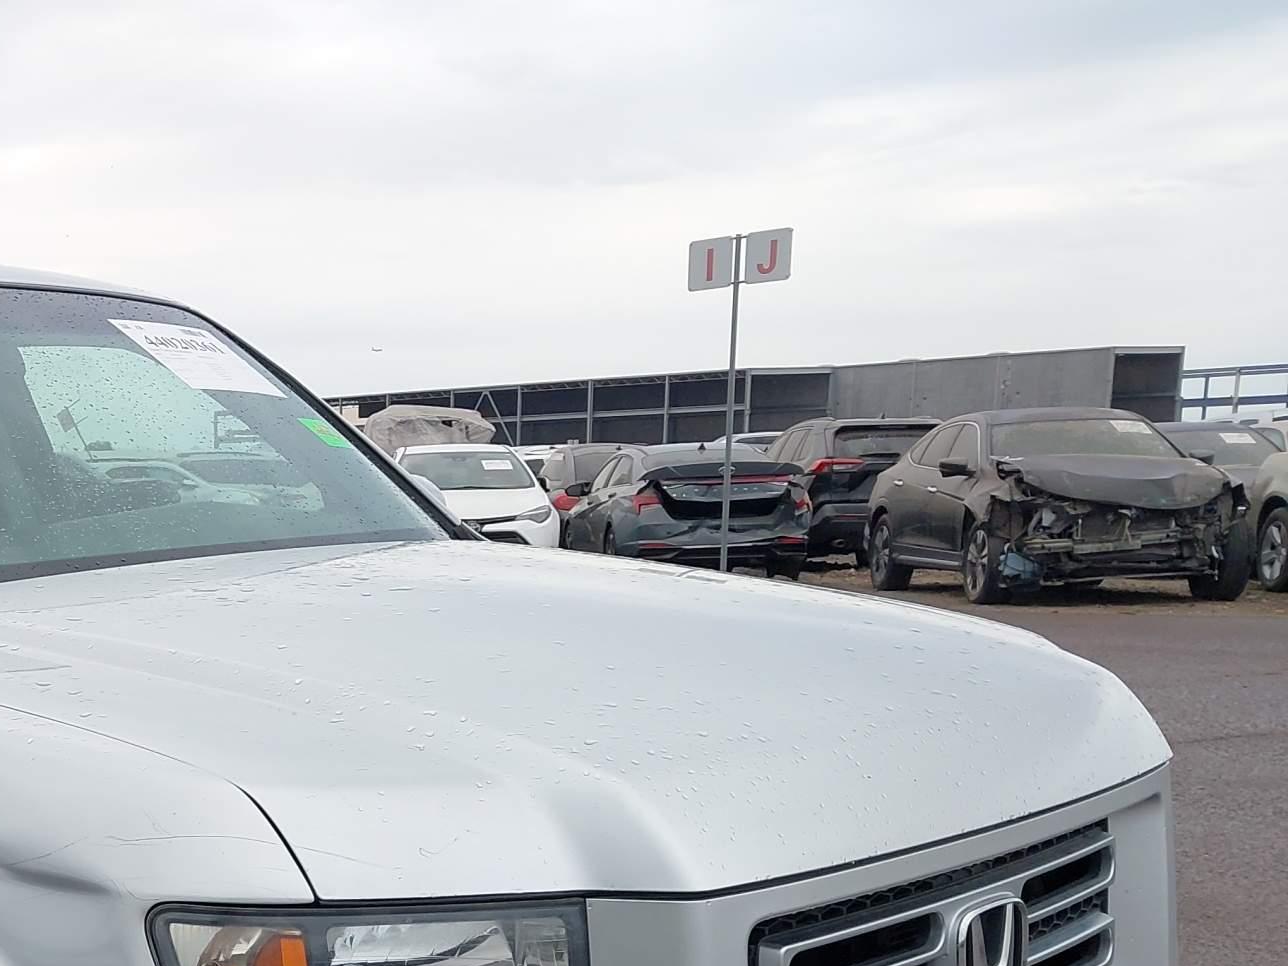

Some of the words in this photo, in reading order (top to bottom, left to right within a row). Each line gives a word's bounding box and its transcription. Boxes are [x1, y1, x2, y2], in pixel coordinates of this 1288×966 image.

[706, 248, 714, 281] I
[757, 239, 778, 274] J
[144, 335, 225, 354] 44020361
